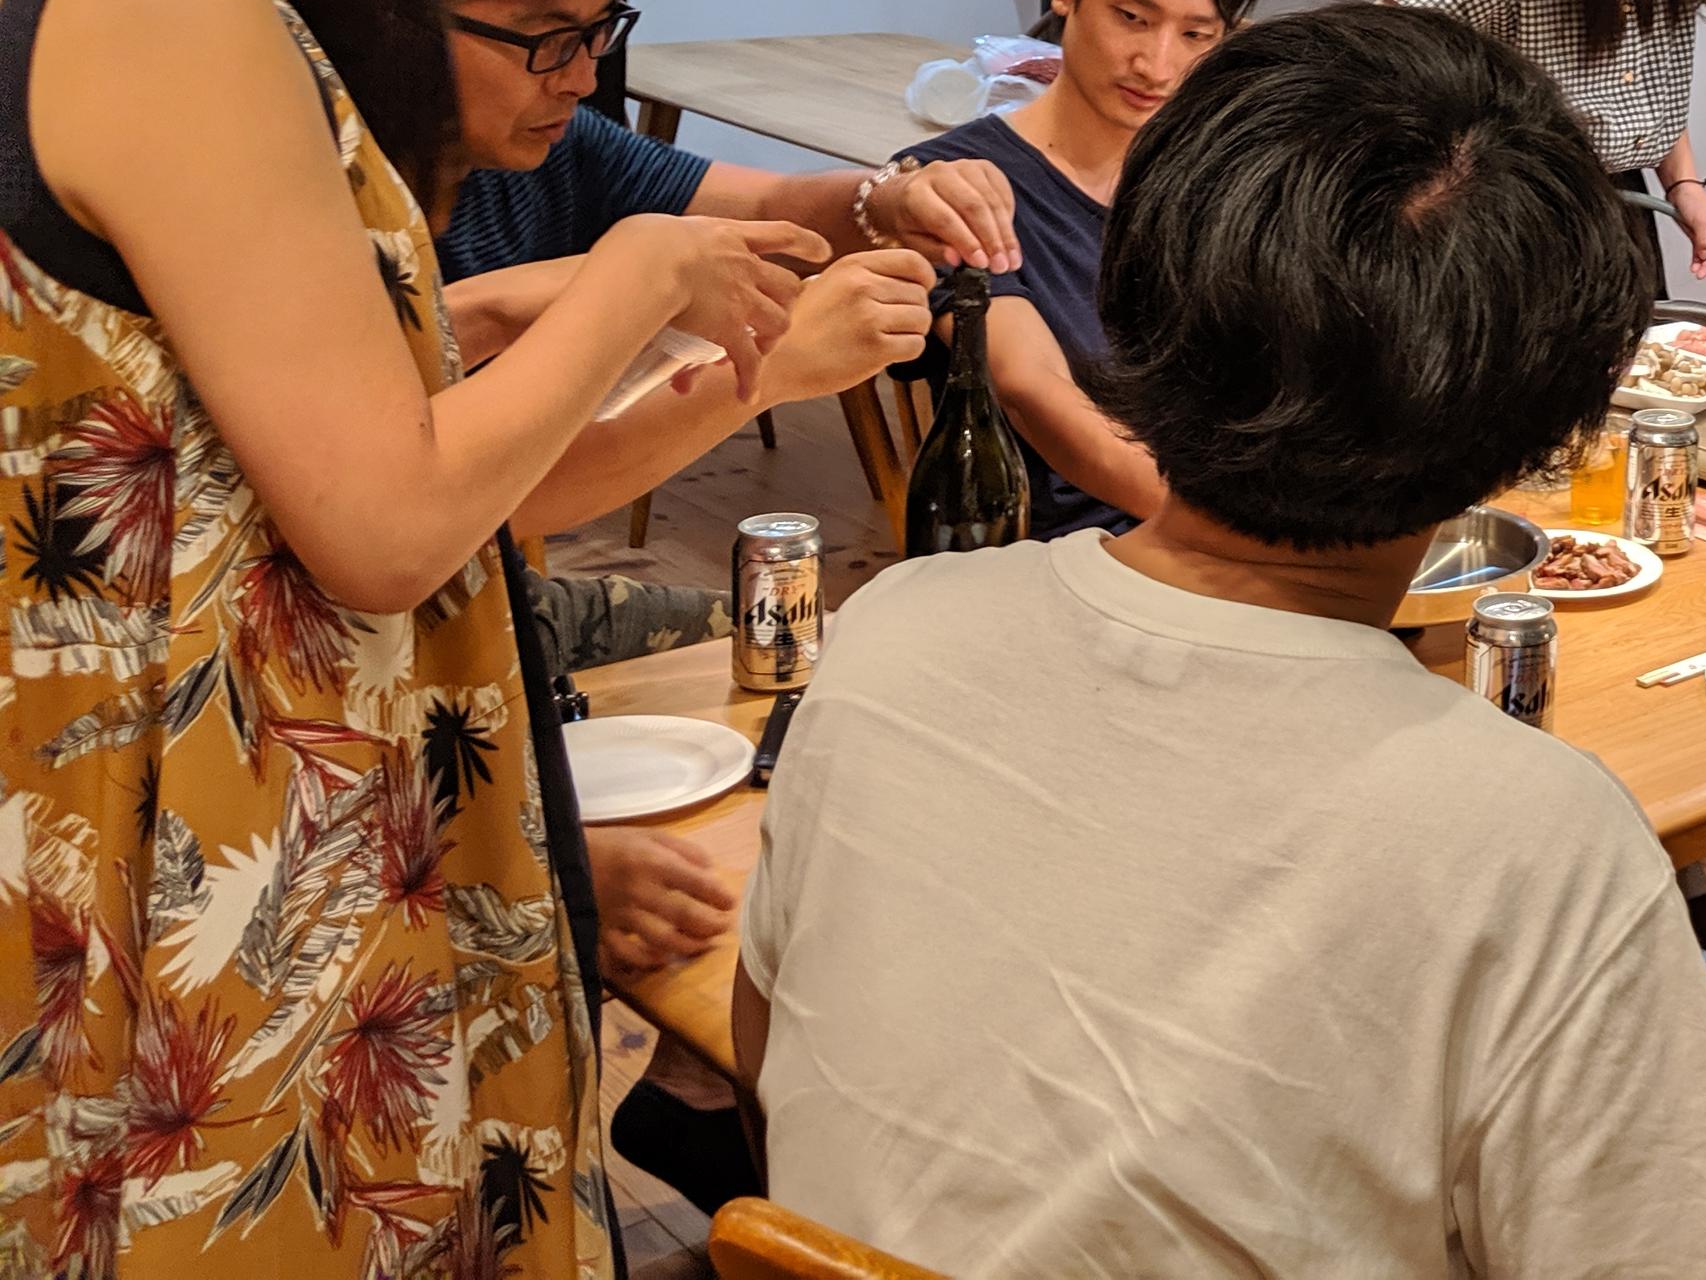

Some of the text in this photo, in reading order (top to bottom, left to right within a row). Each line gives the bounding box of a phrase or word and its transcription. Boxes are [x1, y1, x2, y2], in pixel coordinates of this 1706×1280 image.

[1642, 476, 1693, 502] Asah
[1665, 507, 1681, 518] 生
[745, 592, 818, 627] Asahi
[1491, 679, 1549, 717] Asah
